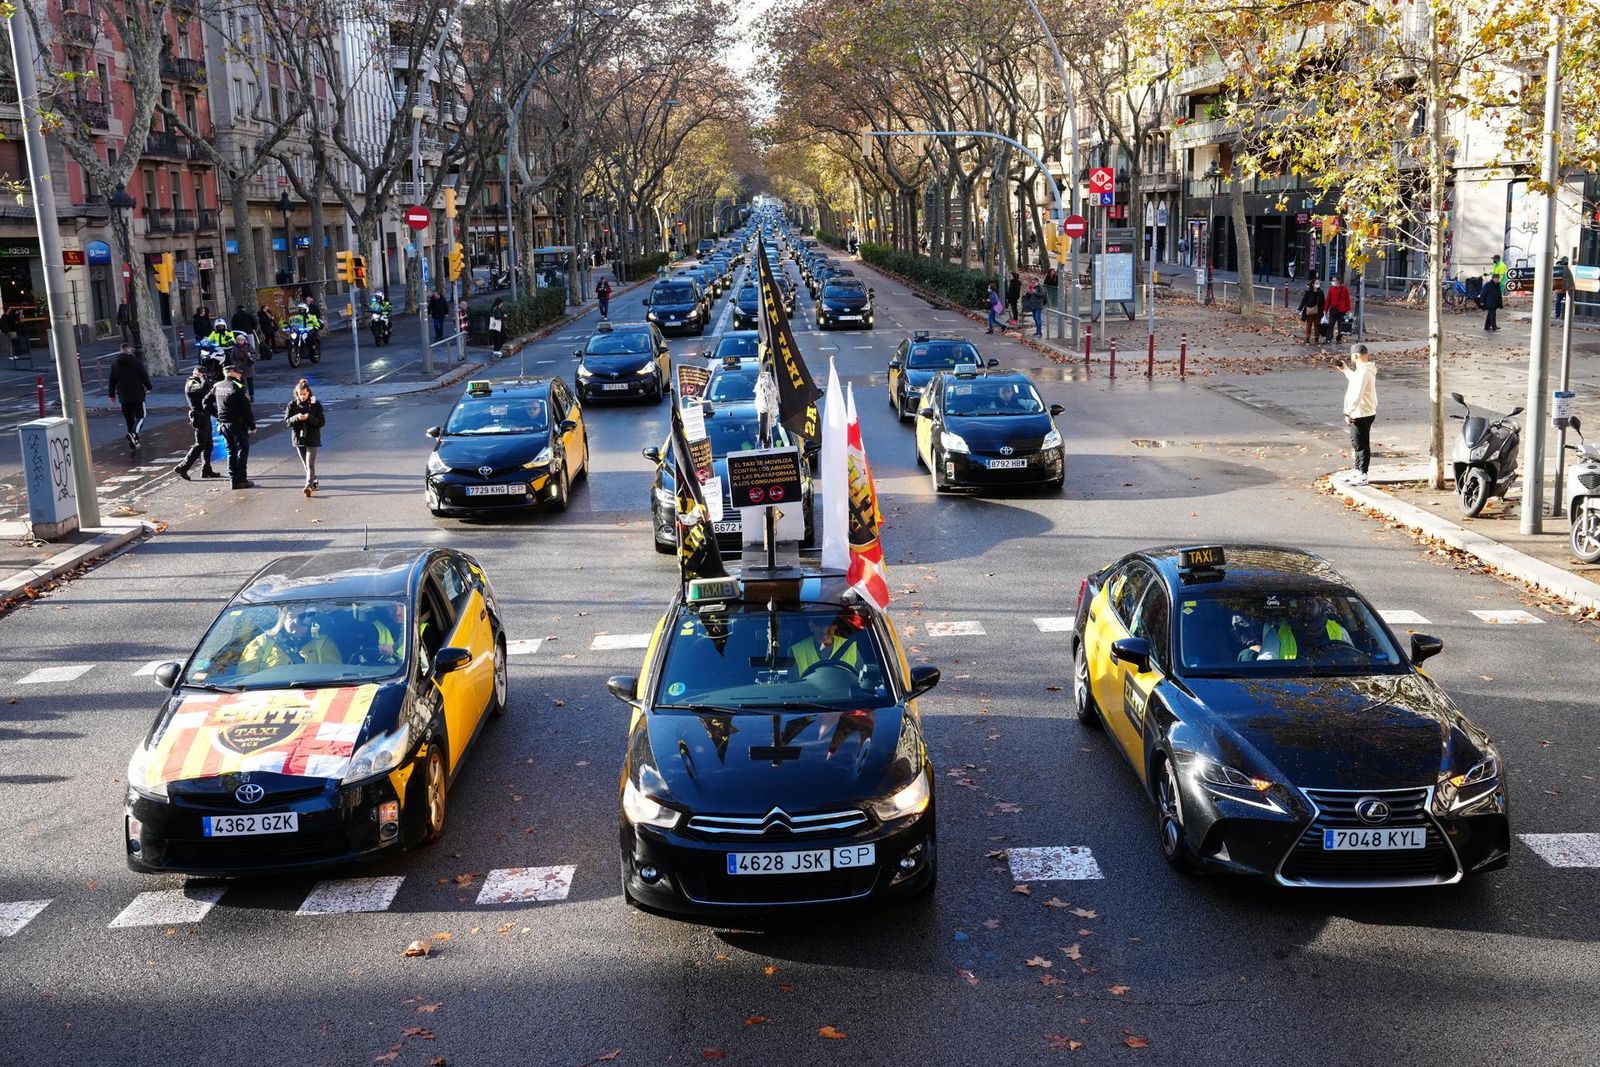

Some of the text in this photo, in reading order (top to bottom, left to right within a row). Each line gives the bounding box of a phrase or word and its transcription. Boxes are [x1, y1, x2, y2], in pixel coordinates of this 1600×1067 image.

[1096, 174, 1105, 182] M
[777, 331, 804, 390] TAXI
[771, 463, 795, 471] ABUSOS
[754, 470, 797, 478] PLATAFORMAS
[751, 476, 797, 485] CONSUMIDORES
[471, 486, 488, 494] 7729
[714, 523, 736, 532] 6672
[1189, 550, 1213, 563] TAXI
[701, 583, 722, 599] TAXI
[234, 727, 279, 736] TAXI
[215, 814, 293, 833] 4362 GZK
[1337, 831, 1420, 847] 7048 KYL
[739, 852, 824, 871] 4628 JSK
